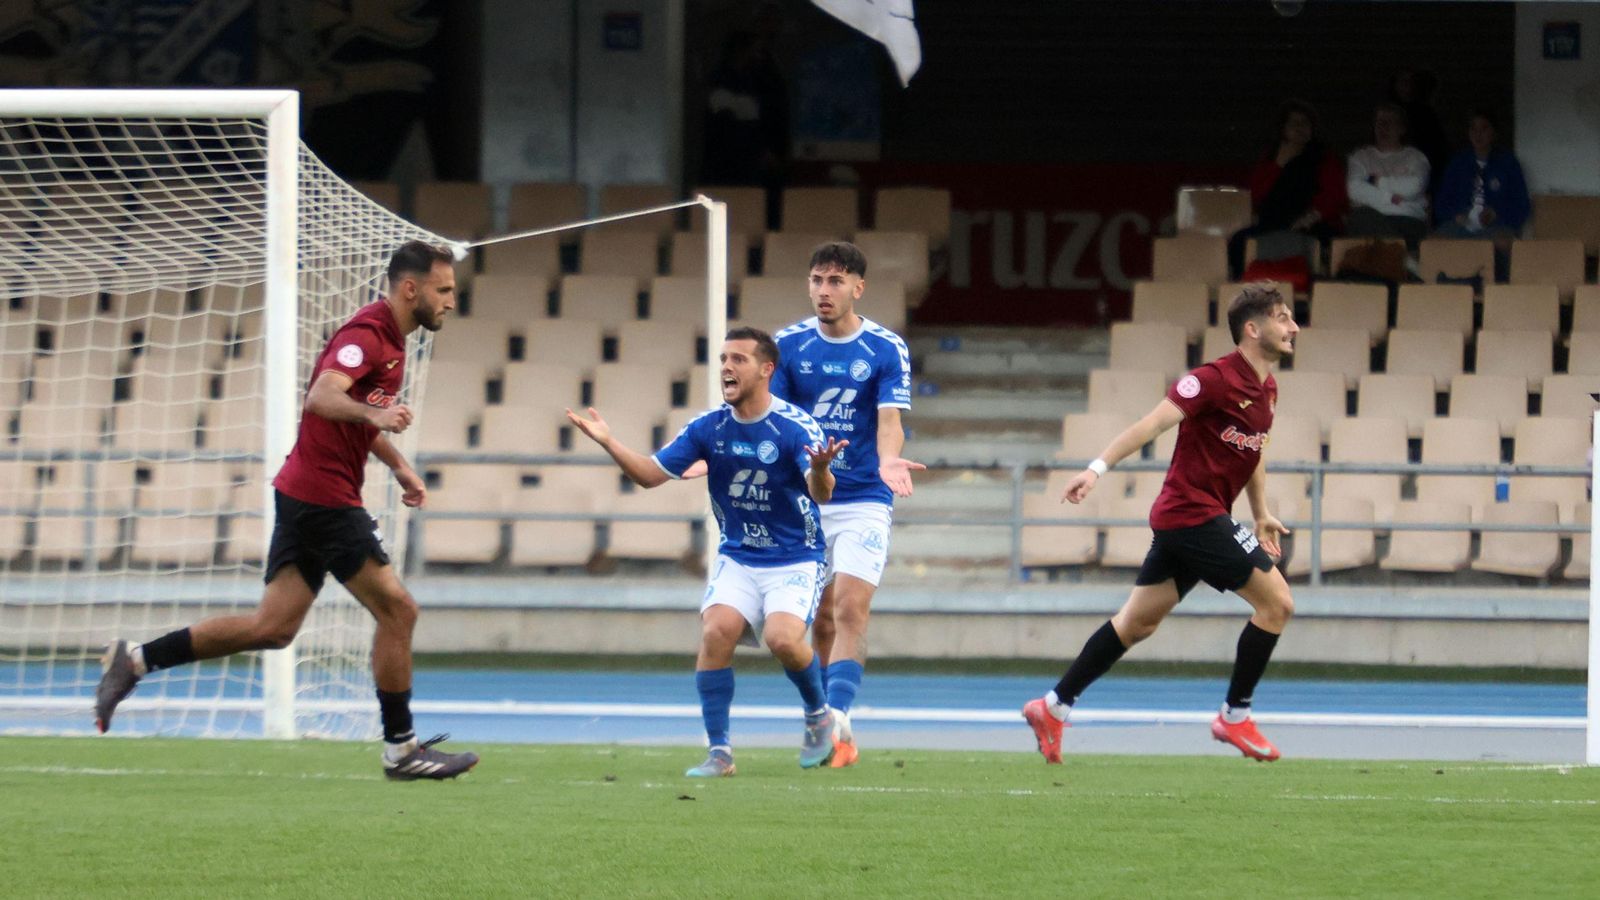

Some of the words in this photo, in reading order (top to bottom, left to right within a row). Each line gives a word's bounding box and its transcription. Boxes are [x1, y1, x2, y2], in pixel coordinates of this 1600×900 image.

[932, 208, 1176, 290] ruzc
[829, 403, 857, 420] Air
[819, 421, 854, 432] neair.es
[745, 484, 772, 501] Air
